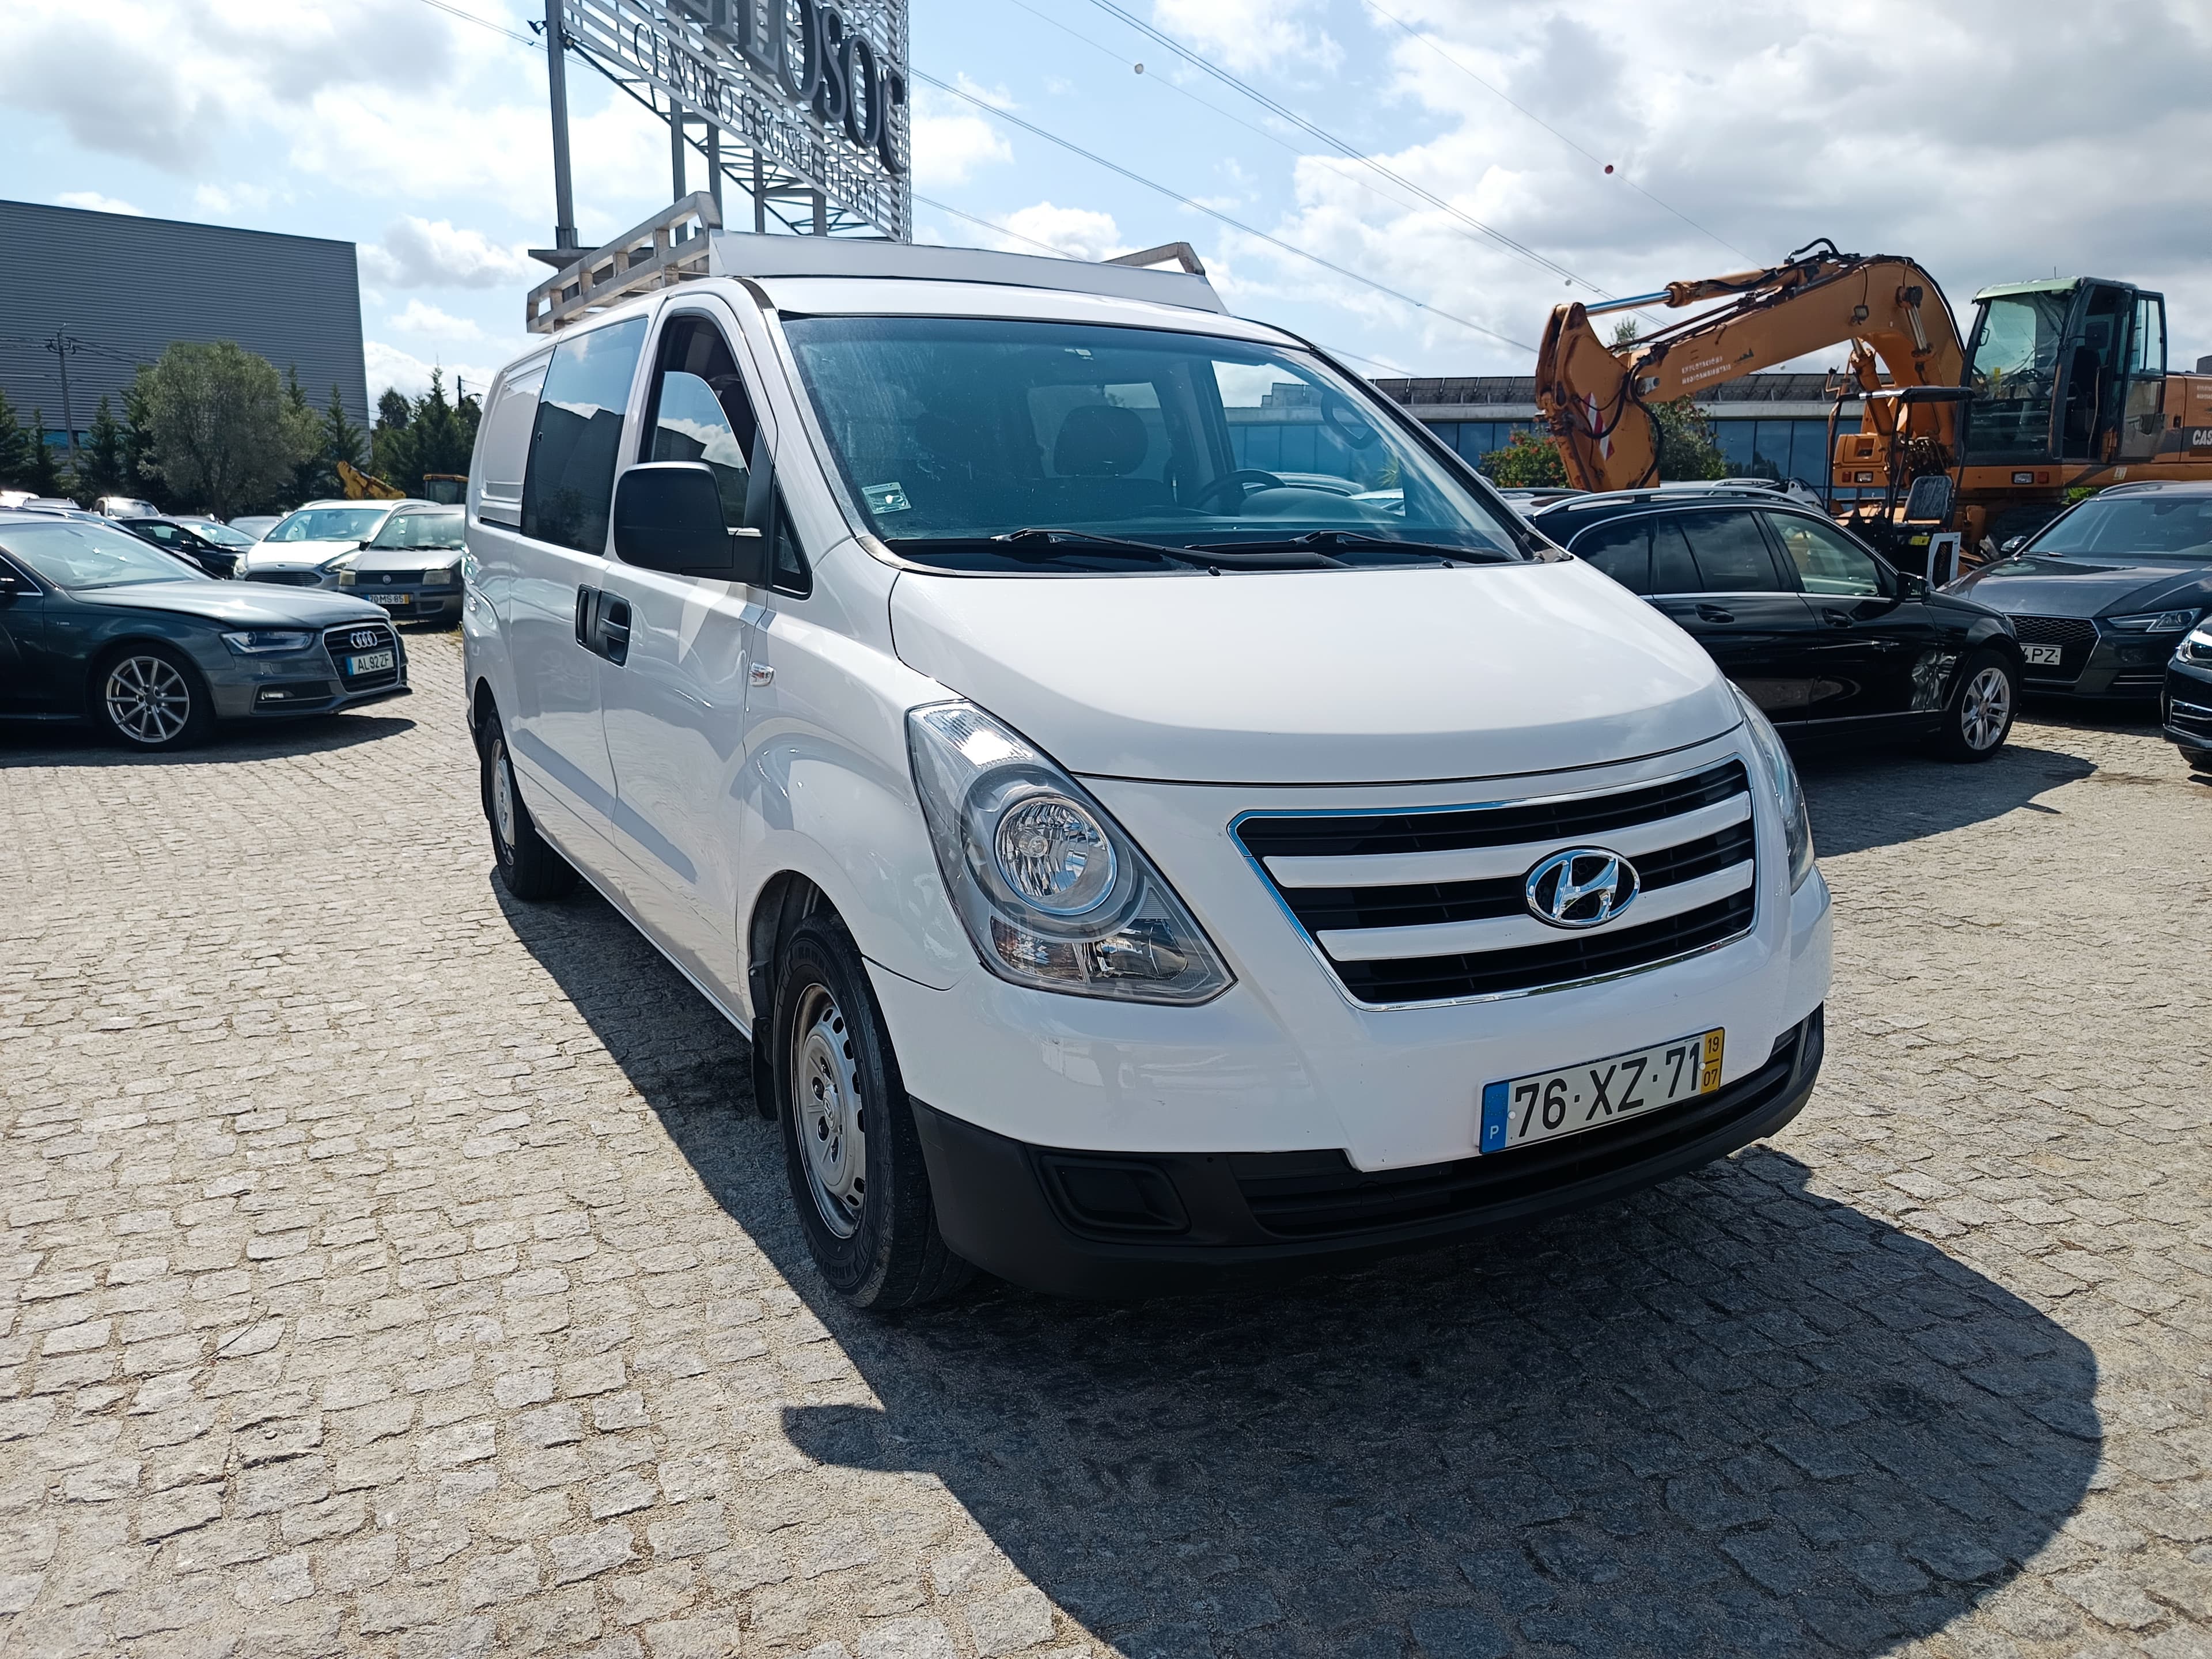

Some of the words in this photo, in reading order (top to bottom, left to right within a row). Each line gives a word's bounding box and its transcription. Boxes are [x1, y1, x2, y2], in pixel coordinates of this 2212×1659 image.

[634, 23, 733, 124] CENTRO
[1707, 1036, 1719, 1054] 19
[1703, 1070, 1718, 1087] 07
[1489, 1125, 1499, 1140] P
